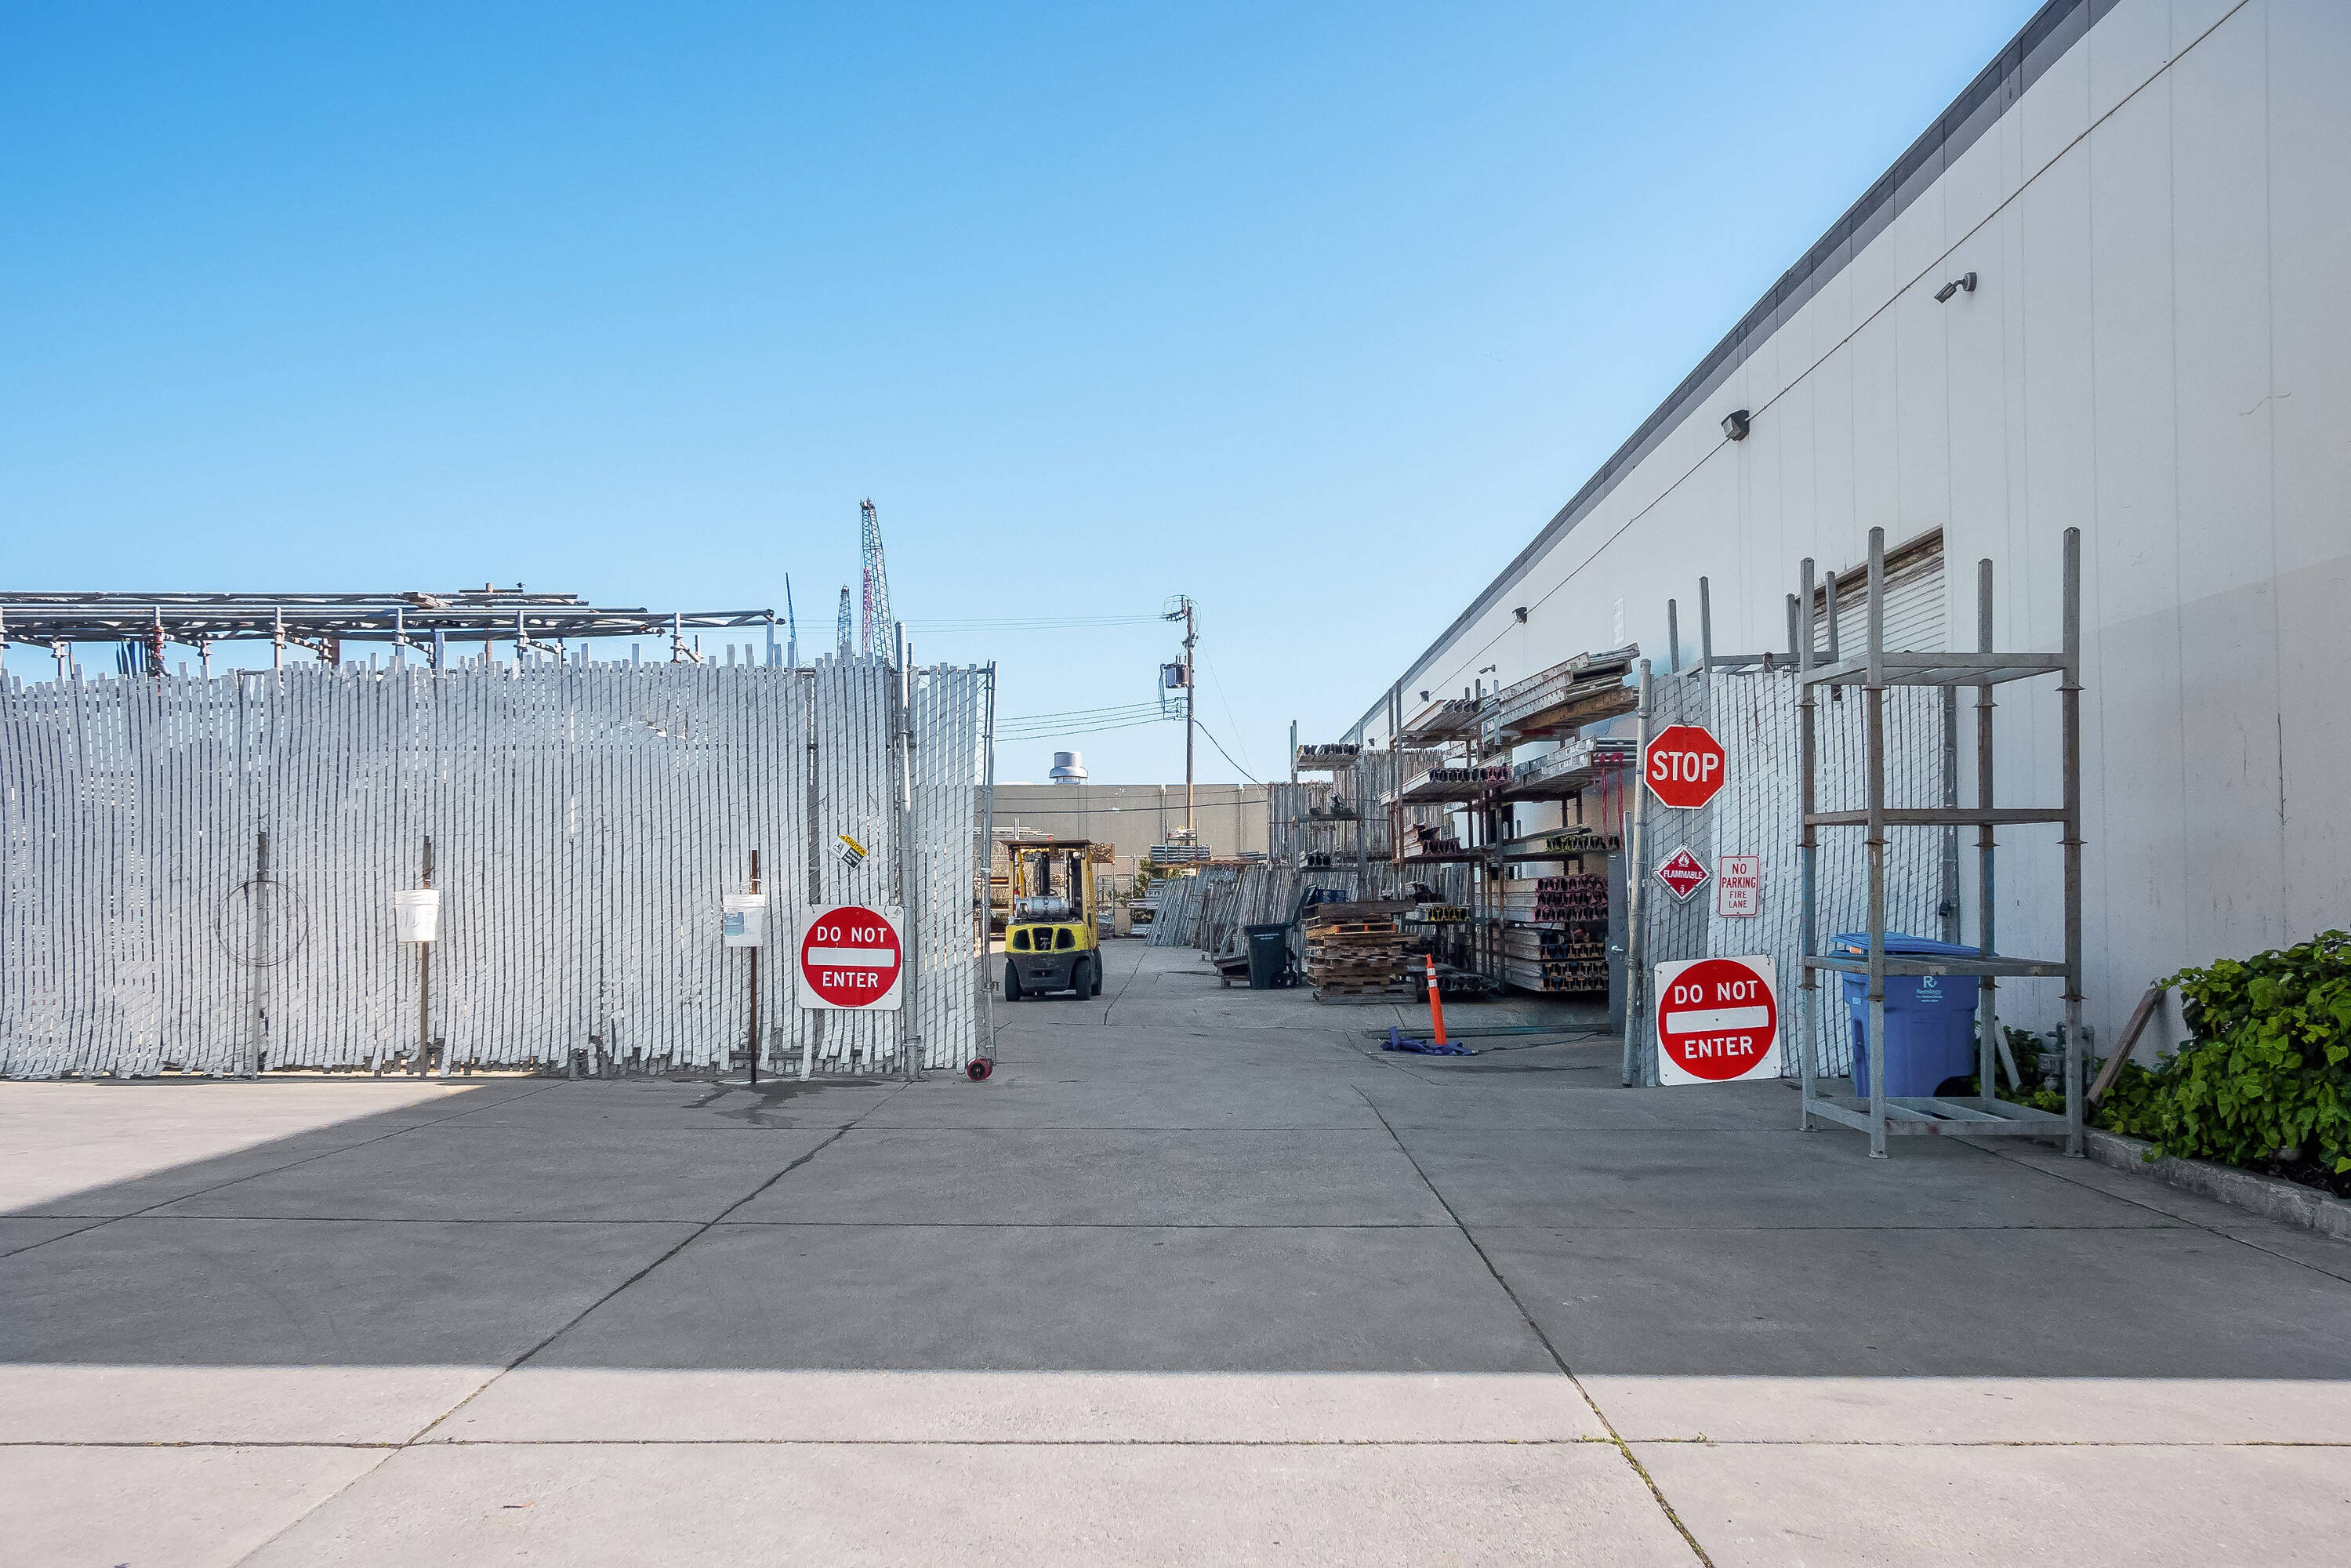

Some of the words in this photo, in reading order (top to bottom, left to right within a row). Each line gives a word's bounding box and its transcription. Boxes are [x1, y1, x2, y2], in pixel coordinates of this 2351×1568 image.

[1652, 751, 1719, 782] STOP
[845, 837, 867, 855] CAUTION
[1663, 869, 1703, 880] FLAMMABLE
[1732, 863, 1747, 875] NO
[1722, 877, 1756, 888] PARKING
[817, 926, 841, 942] DO
[851, 927, 887, 943] NOT
[822, 971, 879, 988] ENTER
[1674, 984, 1703, 1004] DO
[1717, 980, 1758, 1001] NOT
[1685, 1036, 1754, 1059] ENTER
